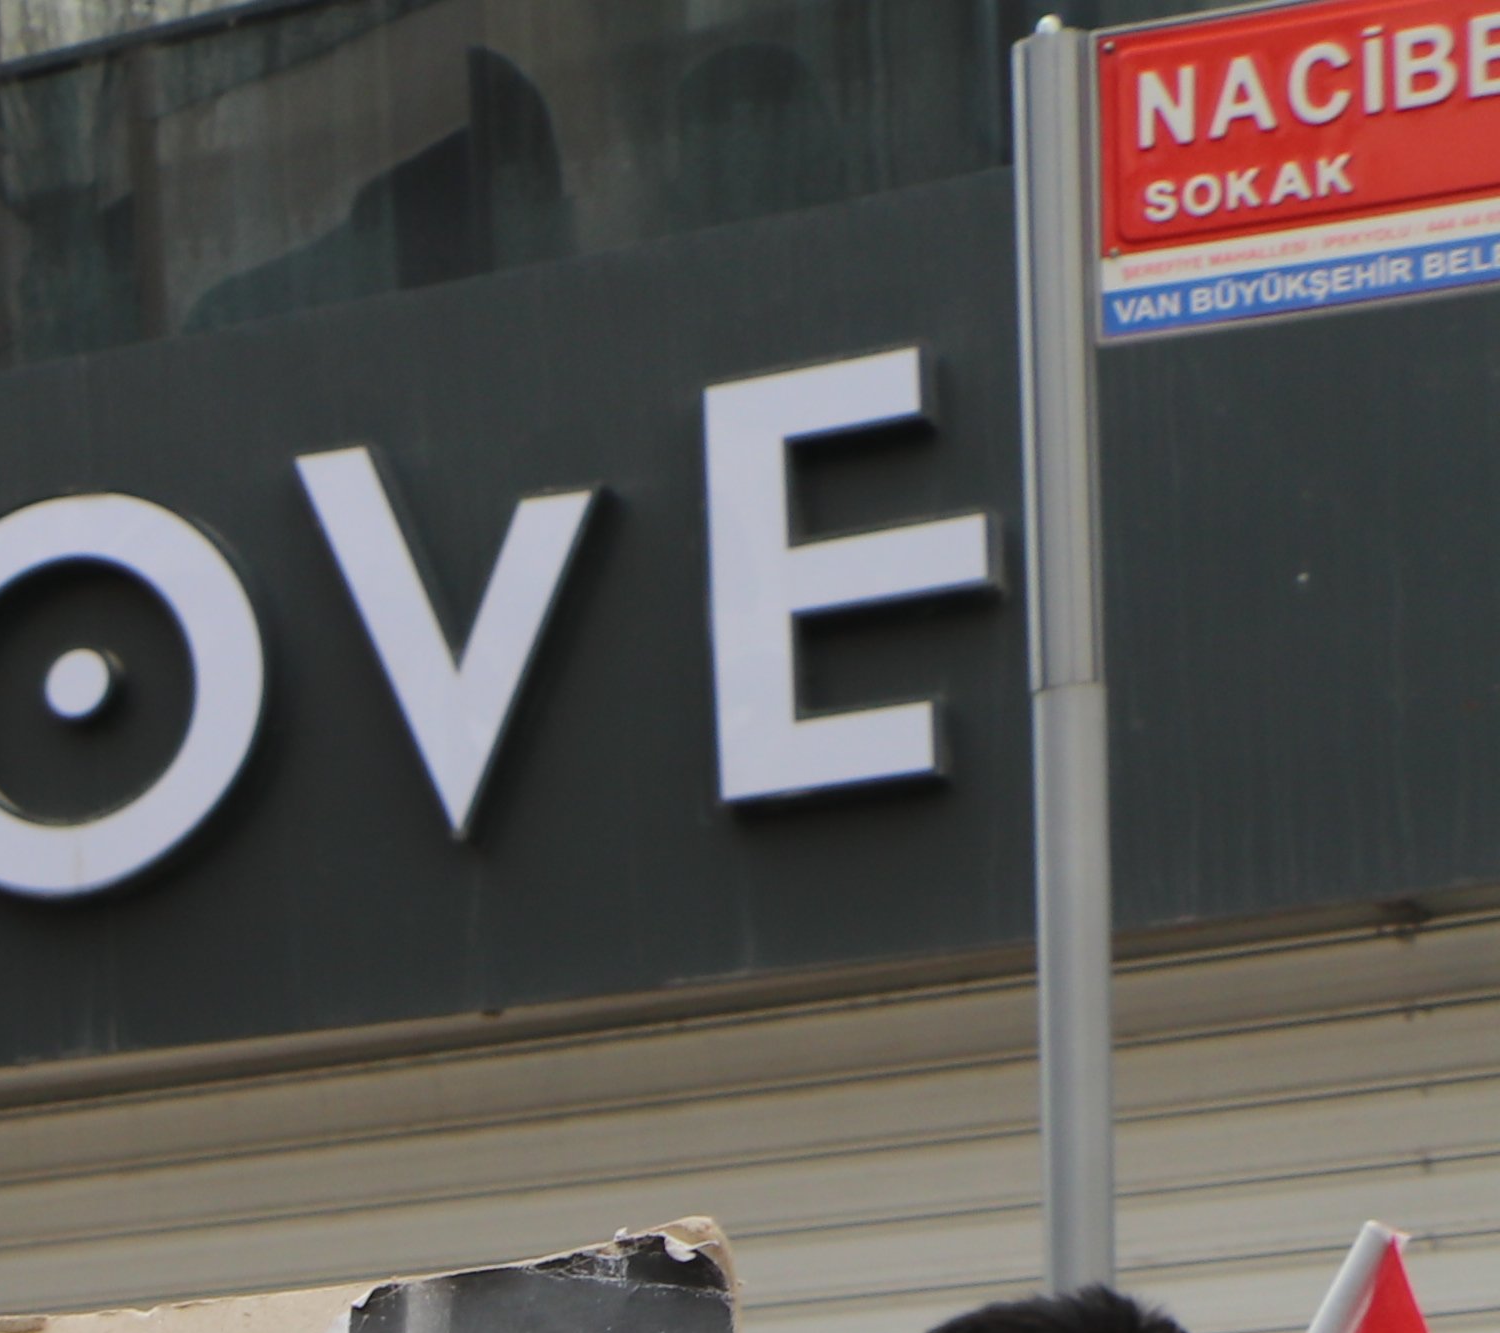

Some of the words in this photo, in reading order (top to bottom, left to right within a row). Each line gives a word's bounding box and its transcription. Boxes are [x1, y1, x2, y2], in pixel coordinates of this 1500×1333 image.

[1143, 153, 1354, 223] SOKAK
[1113, 292, 1181, 324] VAN
[1190, 255, 1413, 314] BÜYÜKŞEHİR
